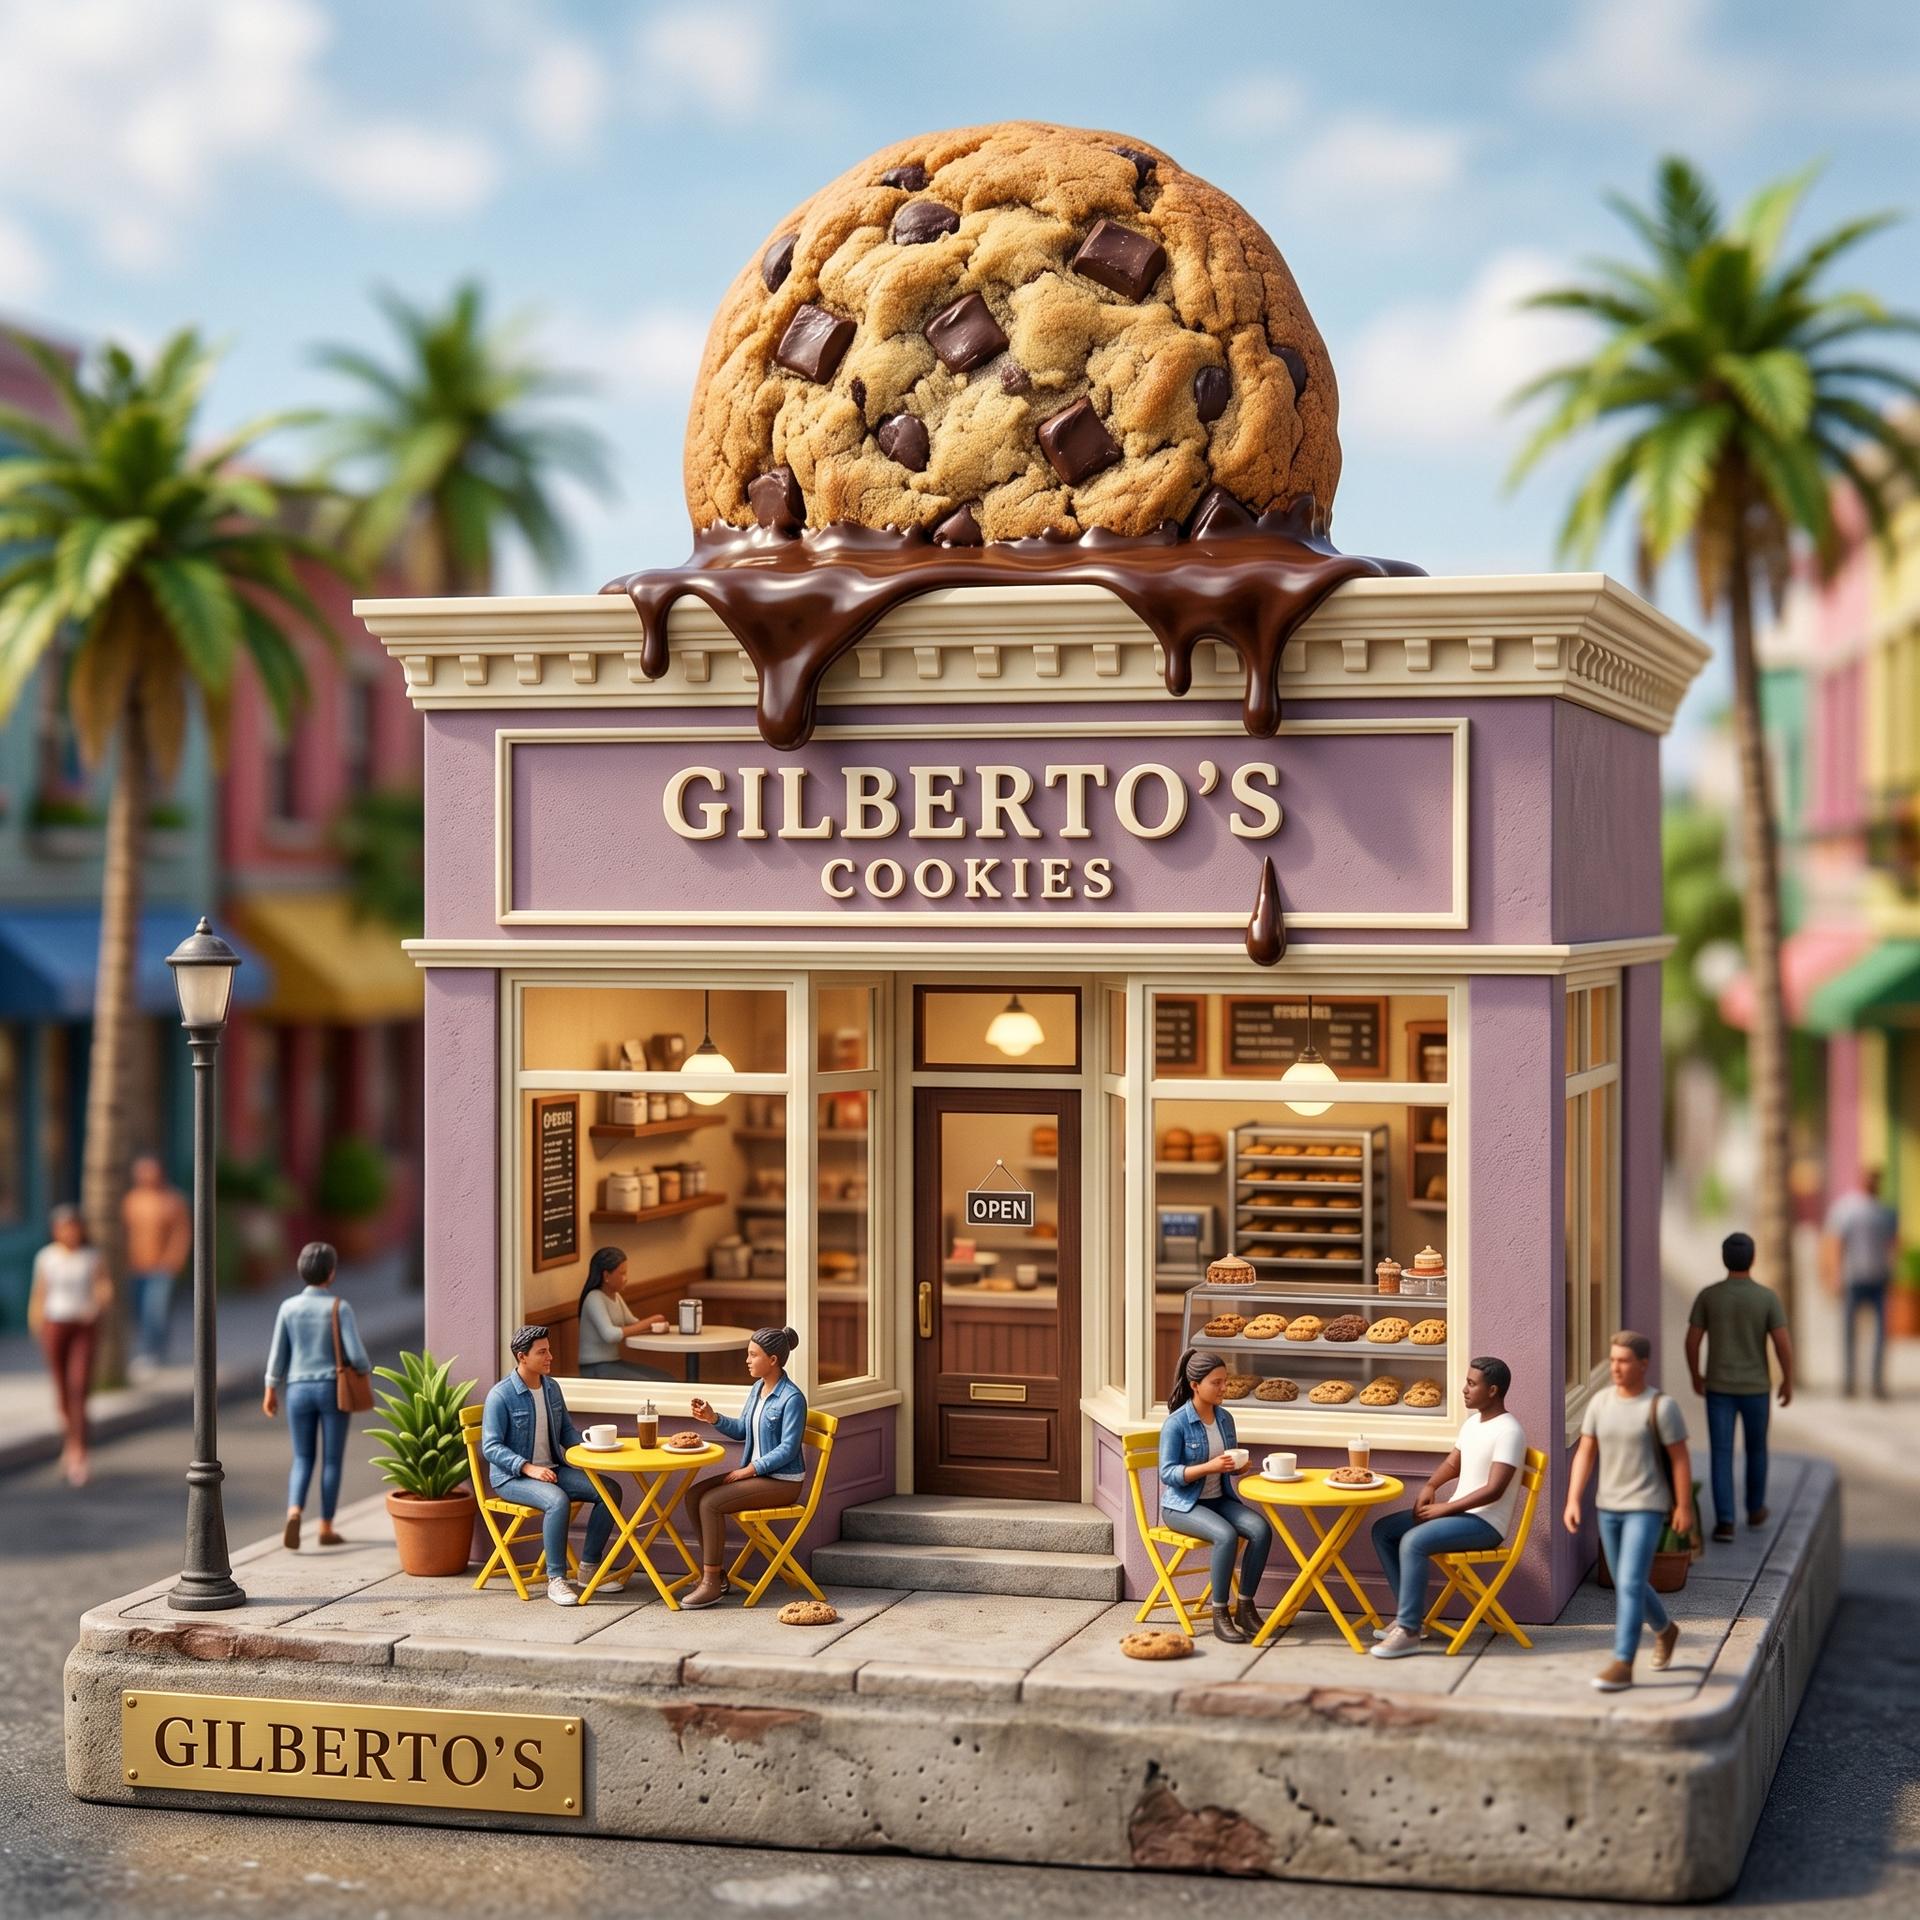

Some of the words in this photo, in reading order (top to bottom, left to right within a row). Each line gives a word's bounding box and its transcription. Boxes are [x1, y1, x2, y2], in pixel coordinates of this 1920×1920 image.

[661, 760, 1284, 841] GILBERTO'S
[820, 857, 1115, 899] COOKIES
[973, 1199, 1026, 1220] OPEN
[154, 1715, 545, 1791] GILBERTO'S
